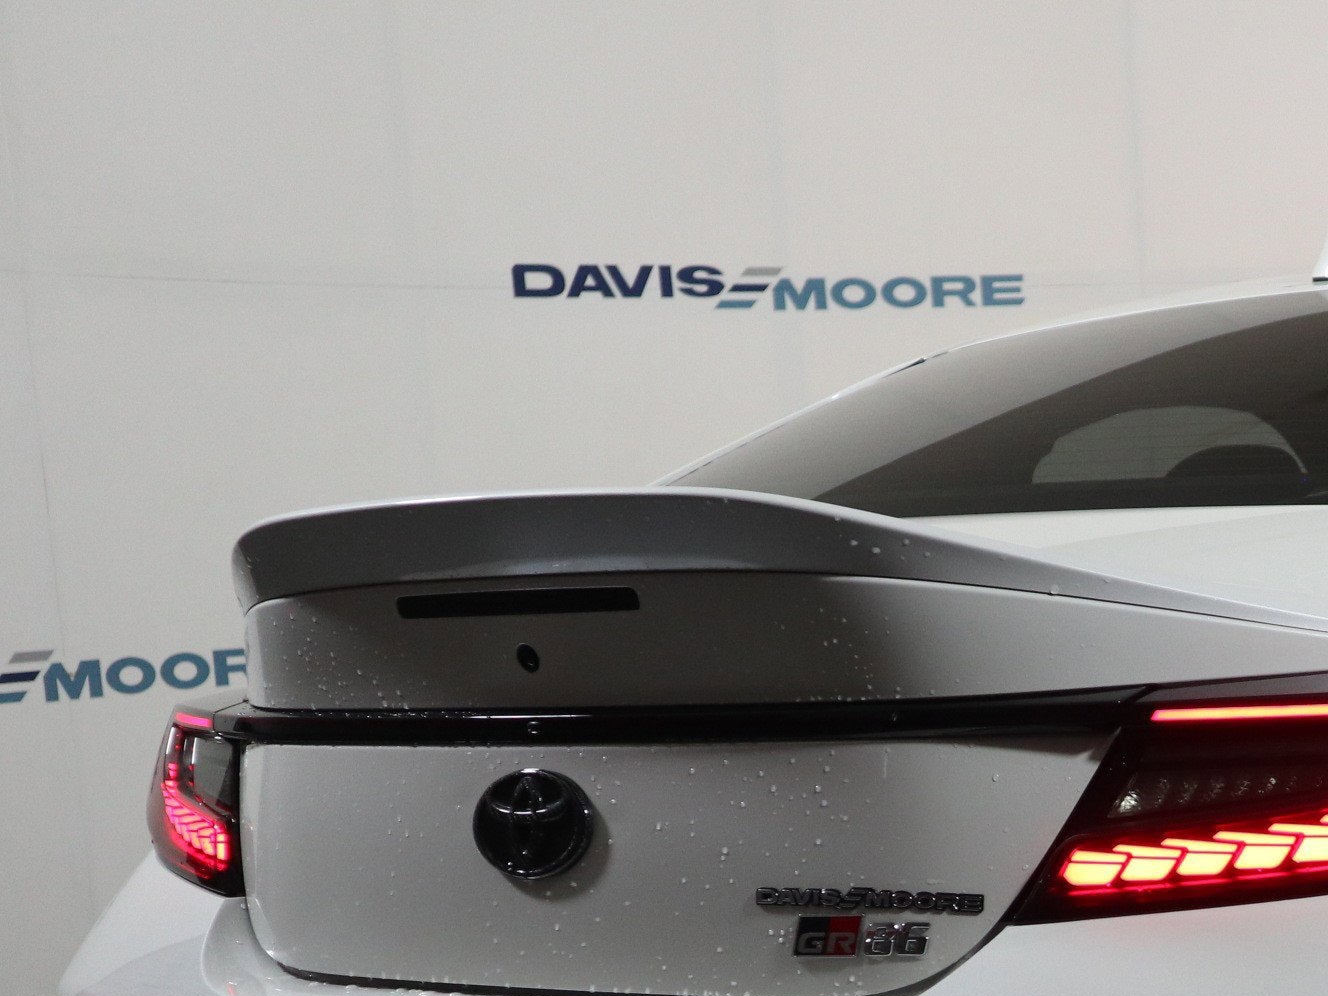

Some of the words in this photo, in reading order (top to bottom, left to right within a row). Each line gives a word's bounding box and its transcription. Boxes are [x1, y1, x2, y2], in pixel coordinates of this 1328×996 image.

[511, 263, 726, 300] DAVIS
[772, 273, 1026, 313] MOORE
[755, 886, 844, 907] DAVIS
[864, 889, 985, 914] MOORE
[796, 931, 857, 955] GR
[863, 921, 931, 957] 86
